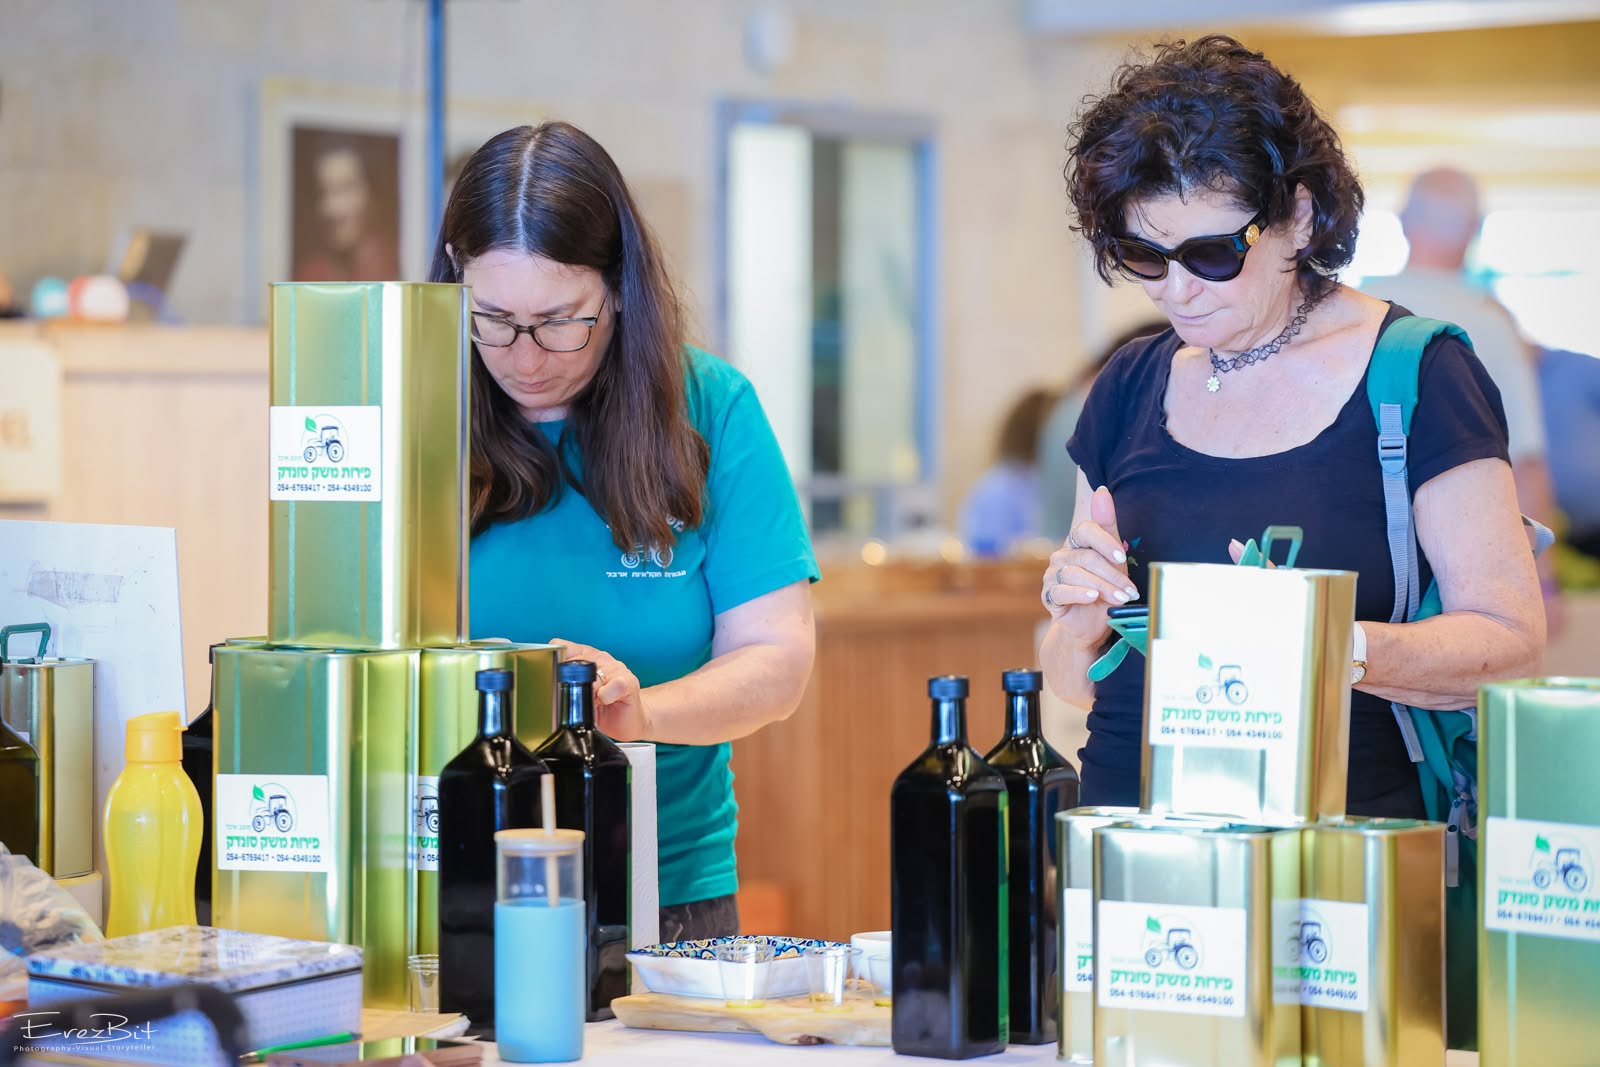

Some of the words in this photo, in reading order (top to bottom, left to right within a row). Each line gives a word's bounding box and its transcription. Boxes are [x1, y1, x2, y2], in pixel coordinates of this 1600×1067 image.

[278, 467, 309, 480] סונדק
[312, 467, 339, 480] משק
[341, 467, 371, 478] פירות
[1162, 707, 1202, 721] סונדק
[1206, 709, 1241, 723] משק
[1245, 711, 1282, 724] פירות
[226, 835, 257, 849] סונדק
[260, 836, 288, 850] משק
[290, 837, 320, 849] פירות
[1111, 970, 1151, 985] סונדק
[1156, 973, 1190, 987] משק
[1195, 976, 1233, 990] פירות
[1324, 969, 1357, 985] פירות
